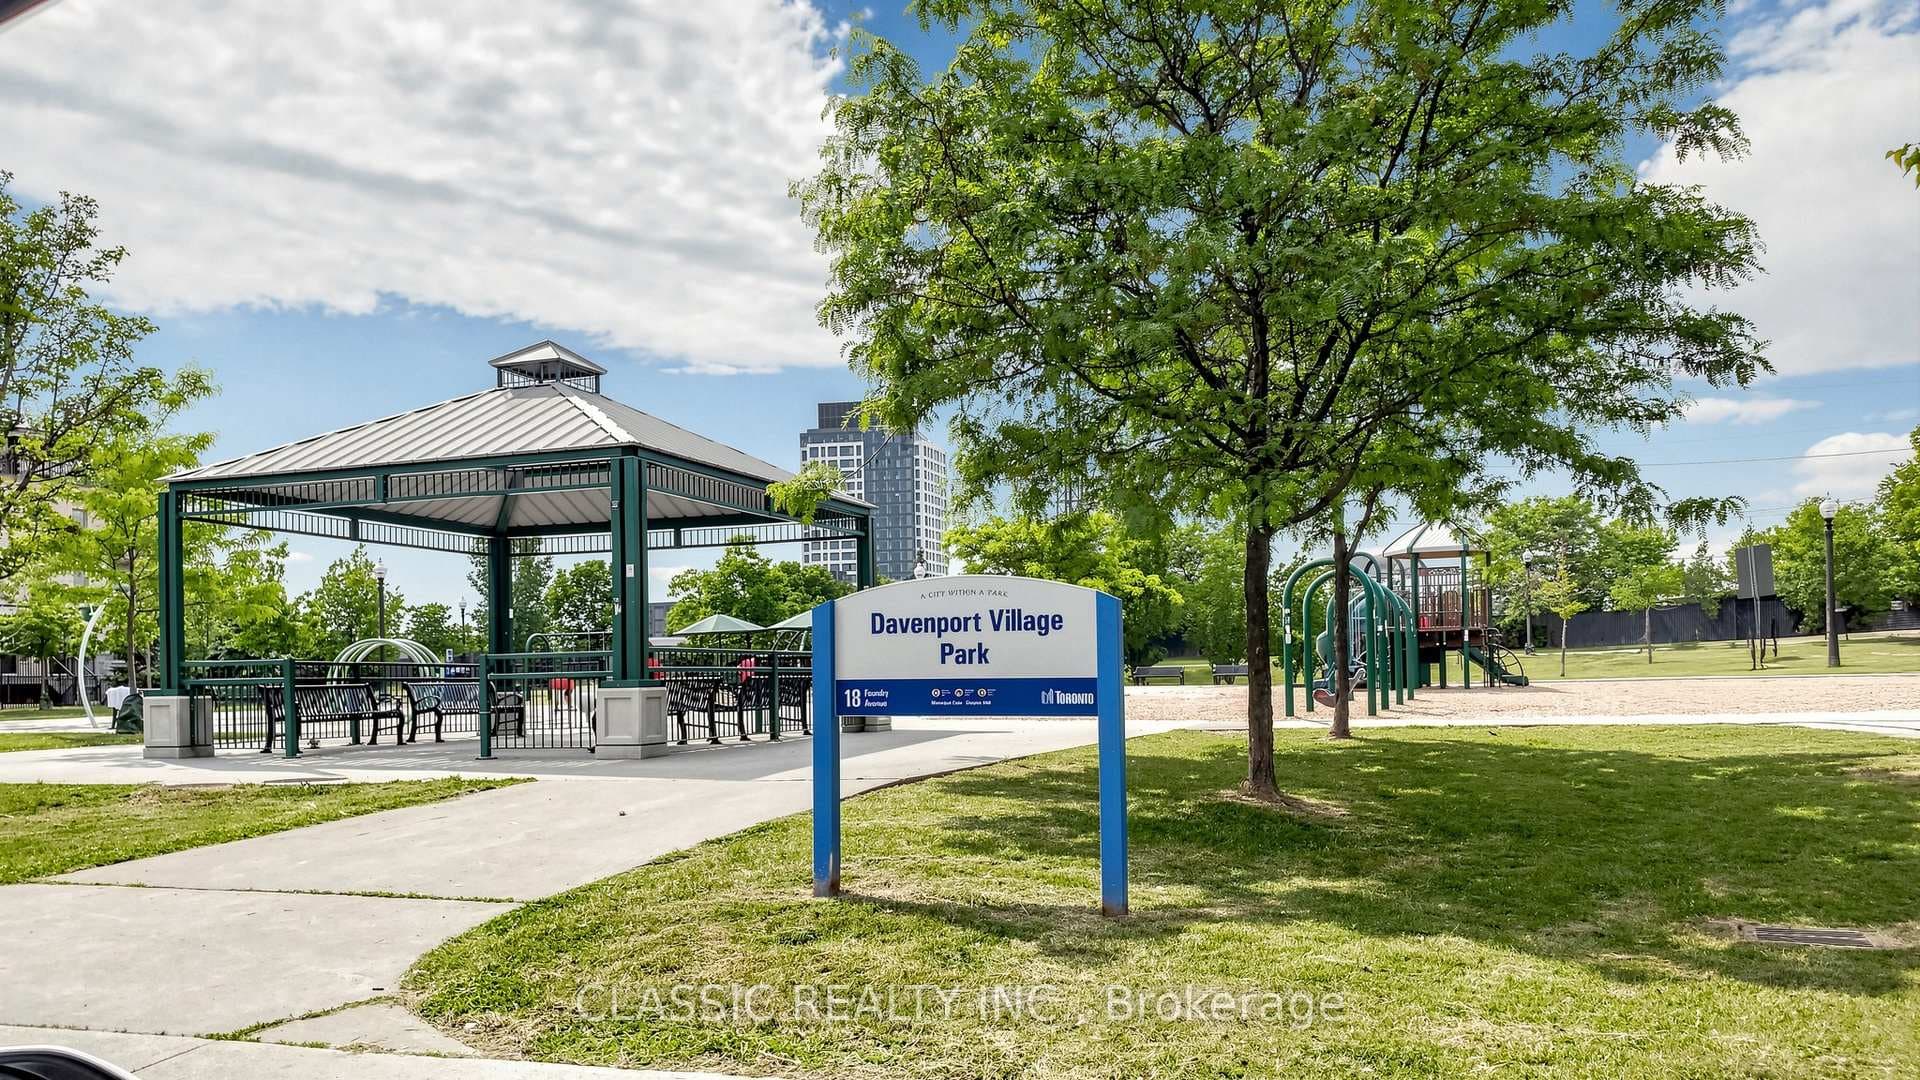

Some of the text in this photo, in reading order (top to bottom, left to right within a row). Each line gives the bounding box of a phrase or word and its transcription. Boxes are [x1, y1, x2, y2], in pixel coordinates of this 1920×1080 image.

[871, 608, 1063, 638] Davenport Village
[940, 642, 989, 665] Park
[844, 689, 861, 708] 18
